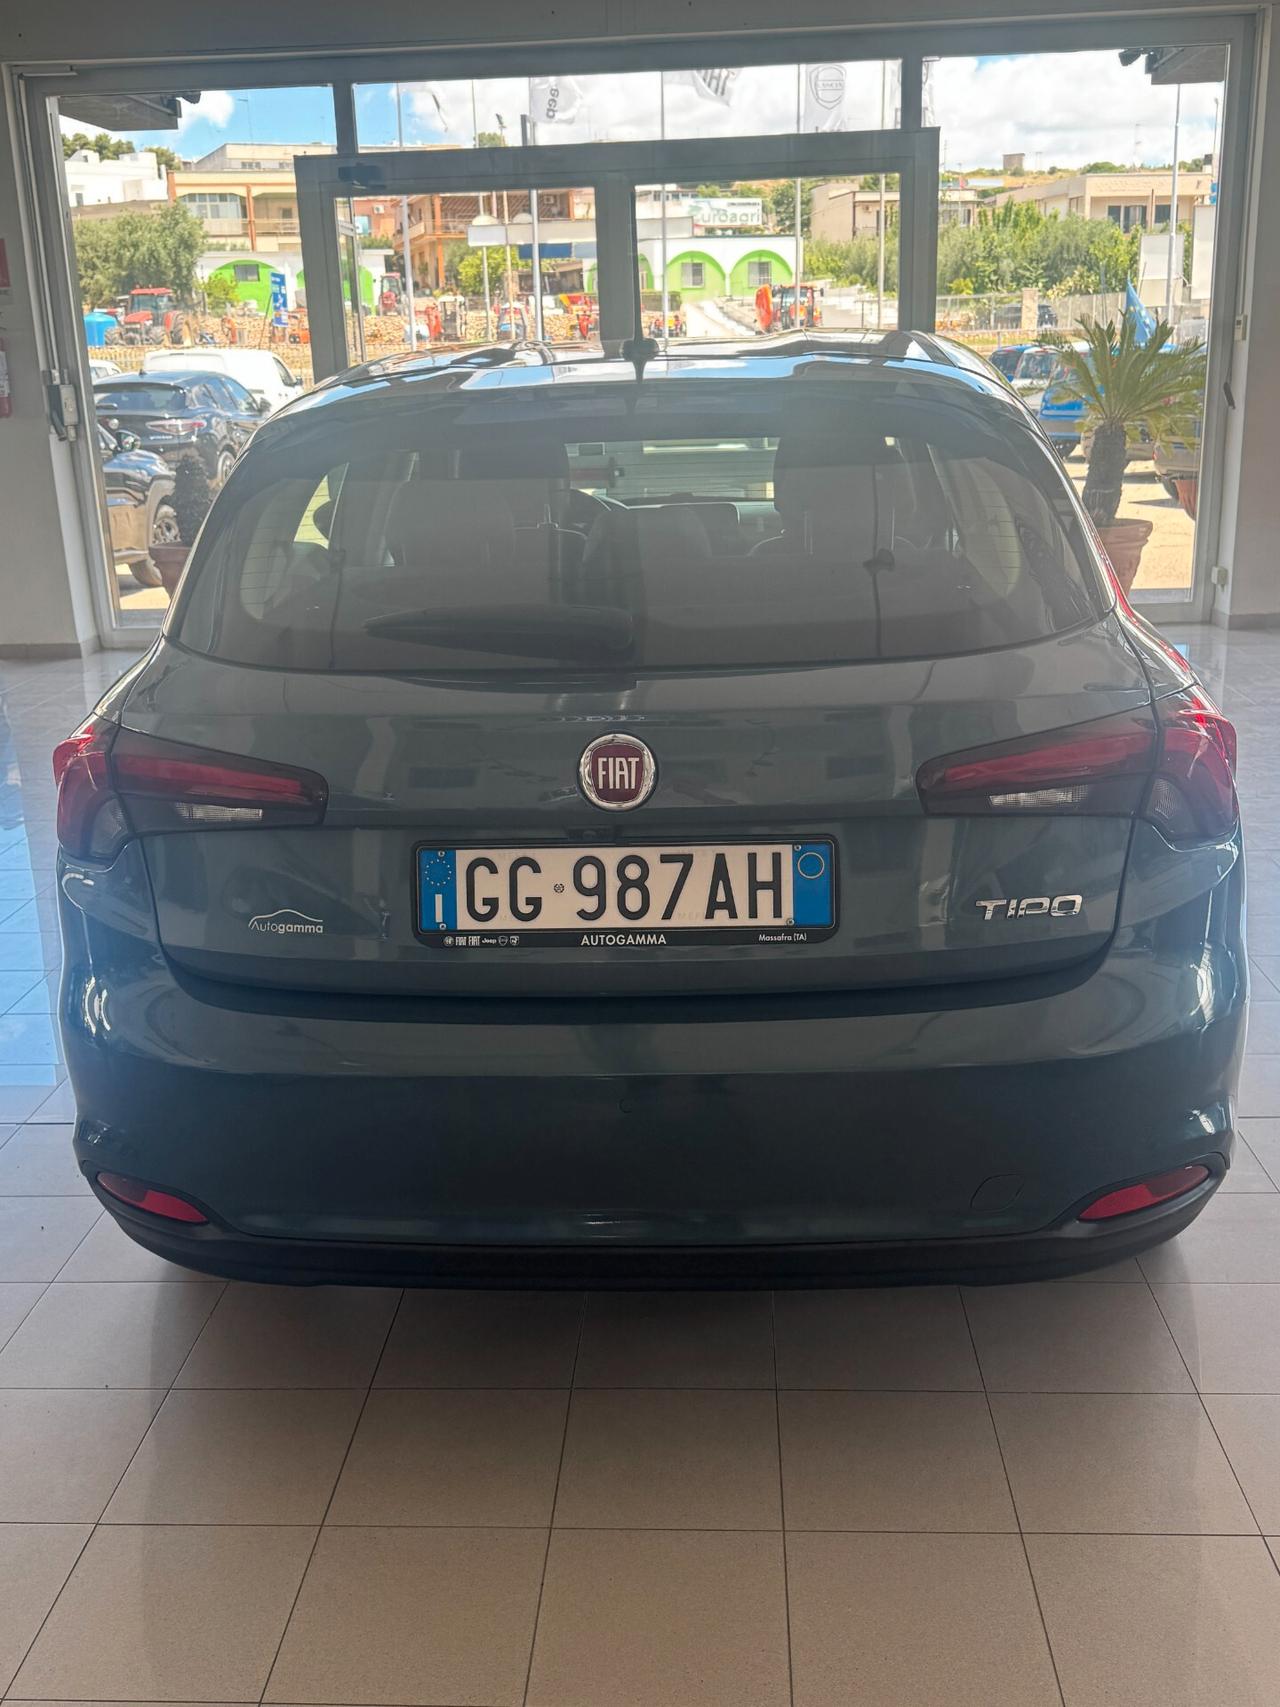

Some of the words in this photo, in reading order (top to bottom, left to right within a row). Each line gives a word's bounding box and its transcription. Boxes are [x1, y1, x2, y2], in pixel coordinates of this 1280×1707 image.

[597, 757, 640, 790] FIAT
[975, 894, 1083, 920] TIPO
[250, 920, 324, 934] Autogamma
[468, 935, 480, 946] FIAT
[580, 933, 667, 946] AUTOGAMMA
[758, 932, 792, 942] Massafra
